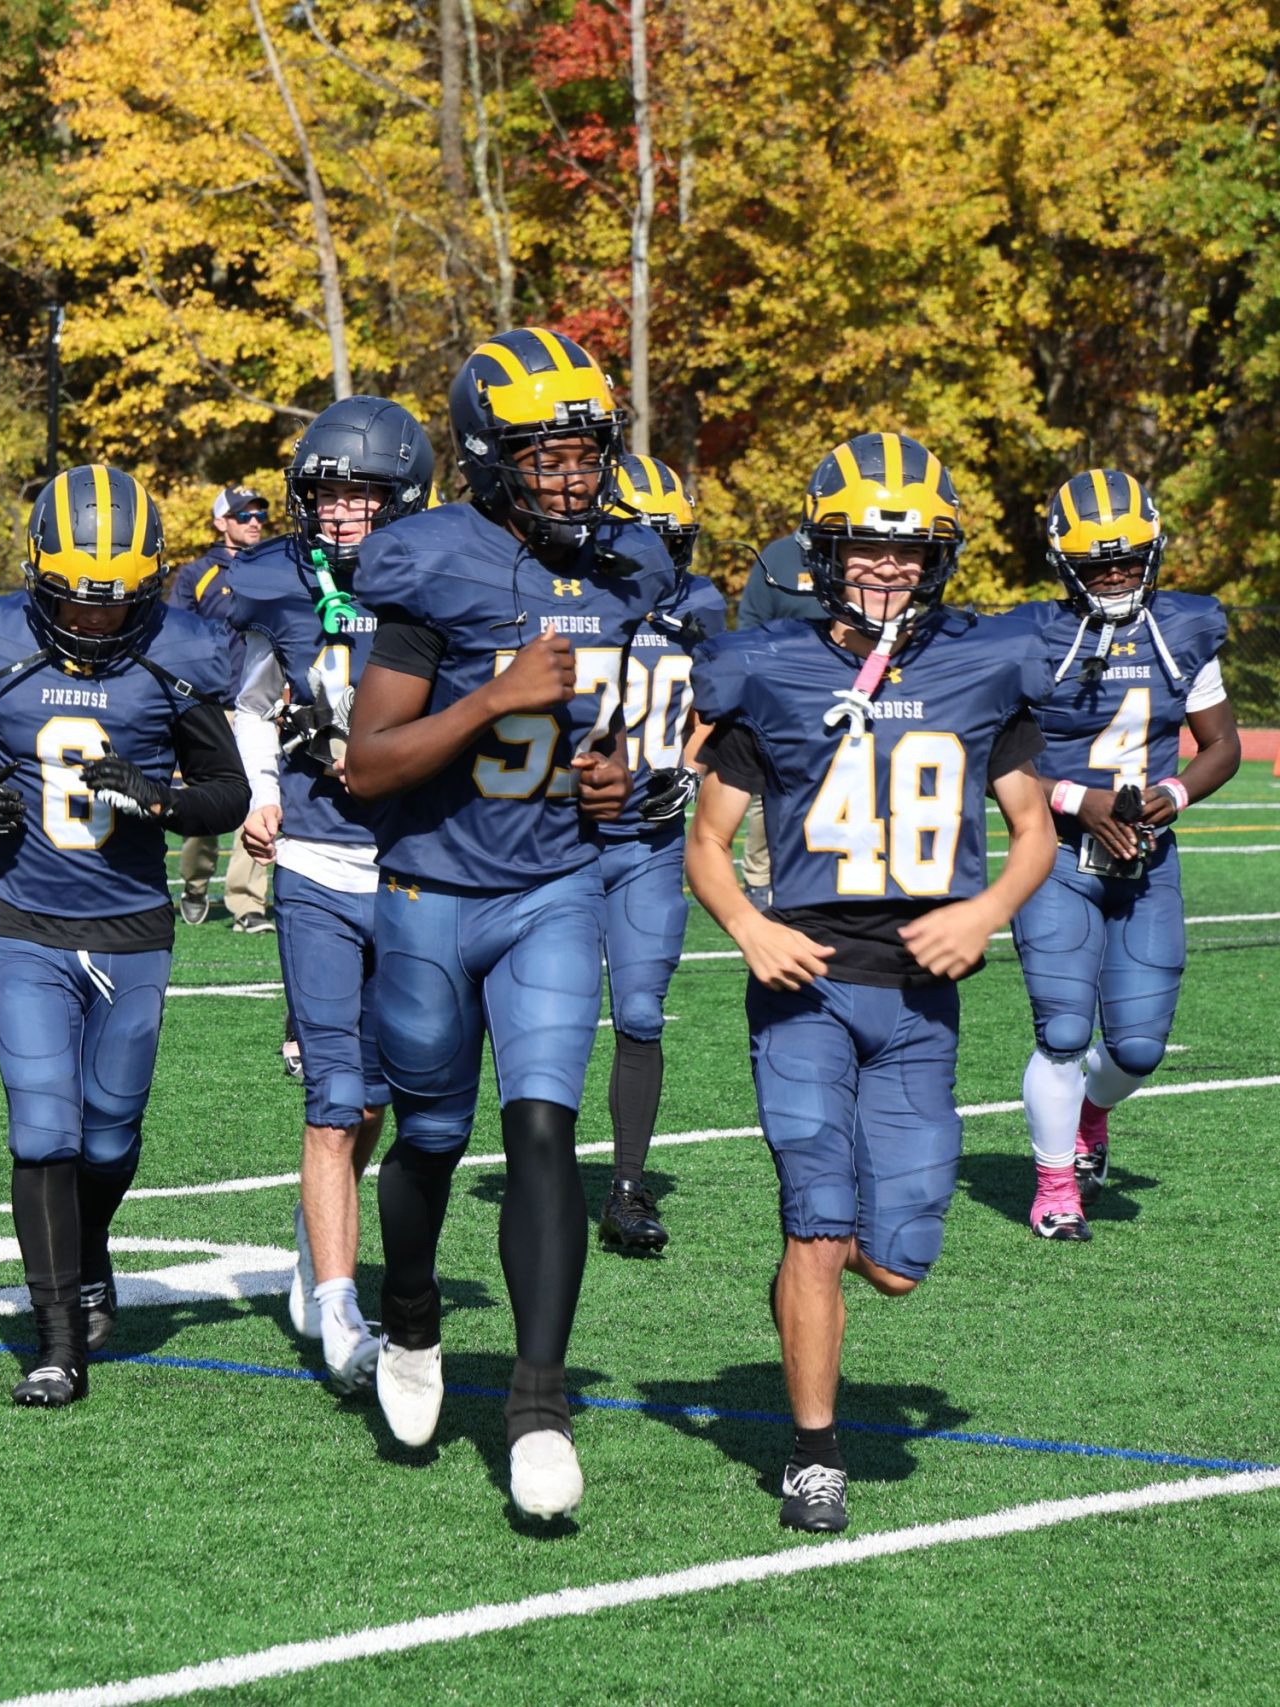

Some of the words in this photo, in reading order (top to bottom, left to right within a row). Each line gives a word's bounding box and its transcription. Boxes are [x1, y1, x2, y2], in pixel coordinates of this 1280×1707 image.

[631, 634, 669, 647] NEBUSH
[1102, 665, 1151, 680] INEBUSH
[42, 688, 108, 709] PINEBUSH
[867, 701, 924, 719] EBUSH
[1088, 688, 1151, 792] 4
[36, 716, 116, 850] 6
[803, 731, 967, 897] 48
